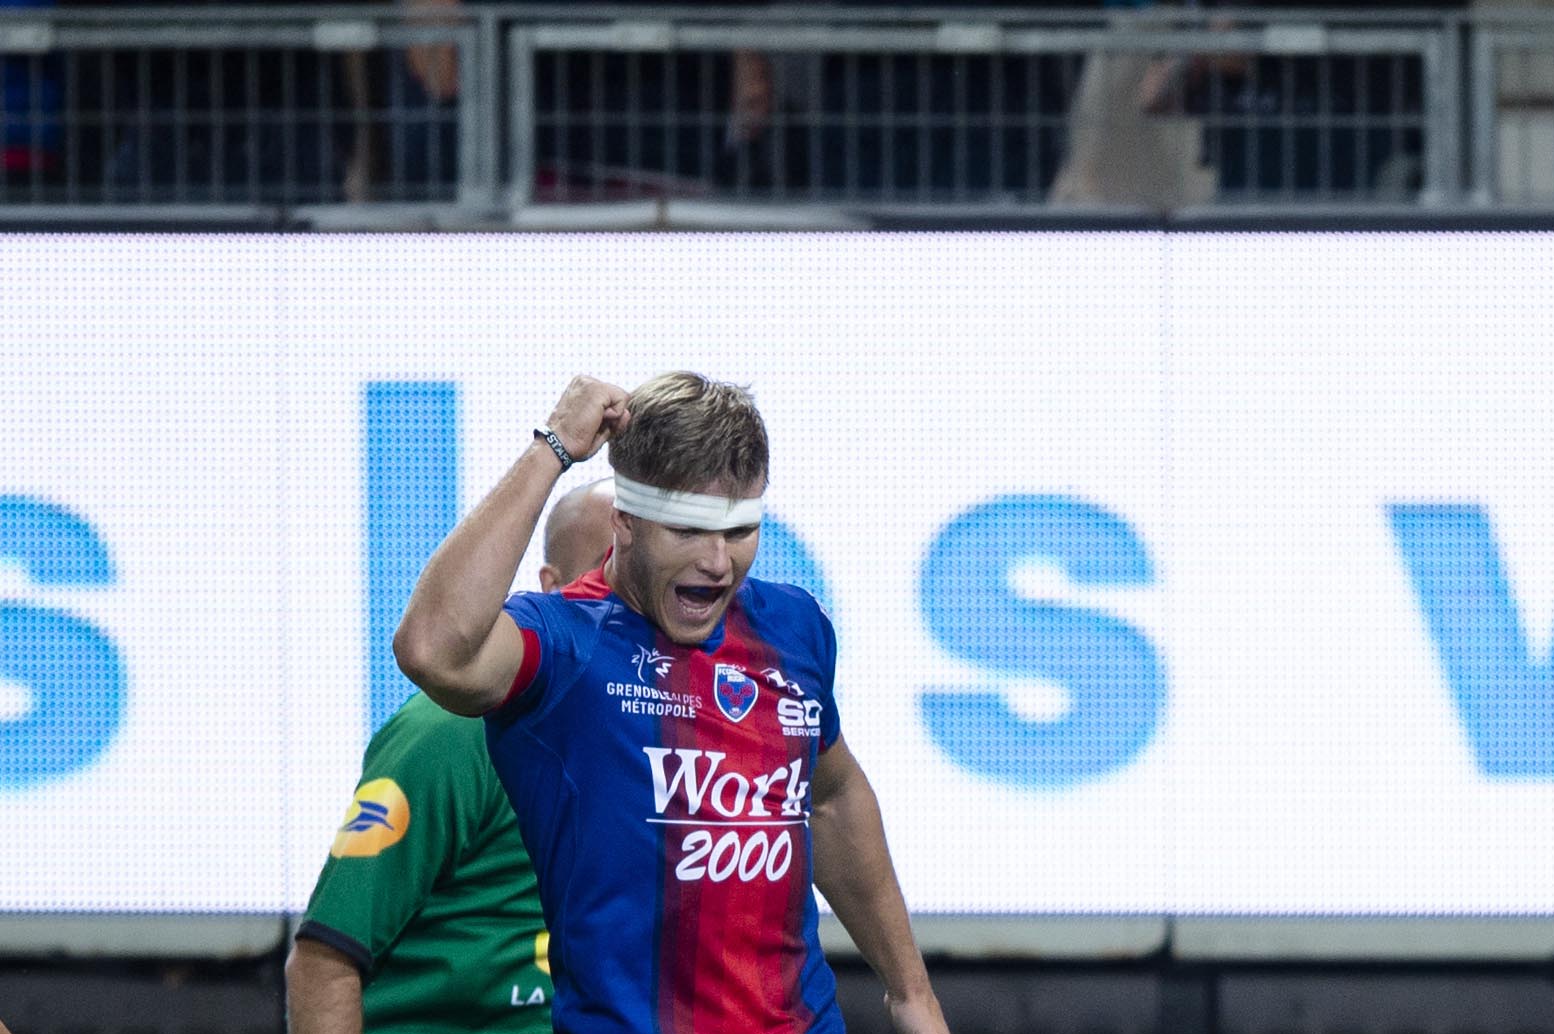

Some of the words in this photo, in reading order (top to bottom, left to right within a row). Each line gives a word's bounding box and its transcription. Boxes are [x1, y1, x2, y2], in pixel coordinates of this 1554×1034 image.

[621, 698, 697, 719] MÉTROPOLE
[675, 829, 793, 883] 2000
[511, 984, 546, 1006] LA
